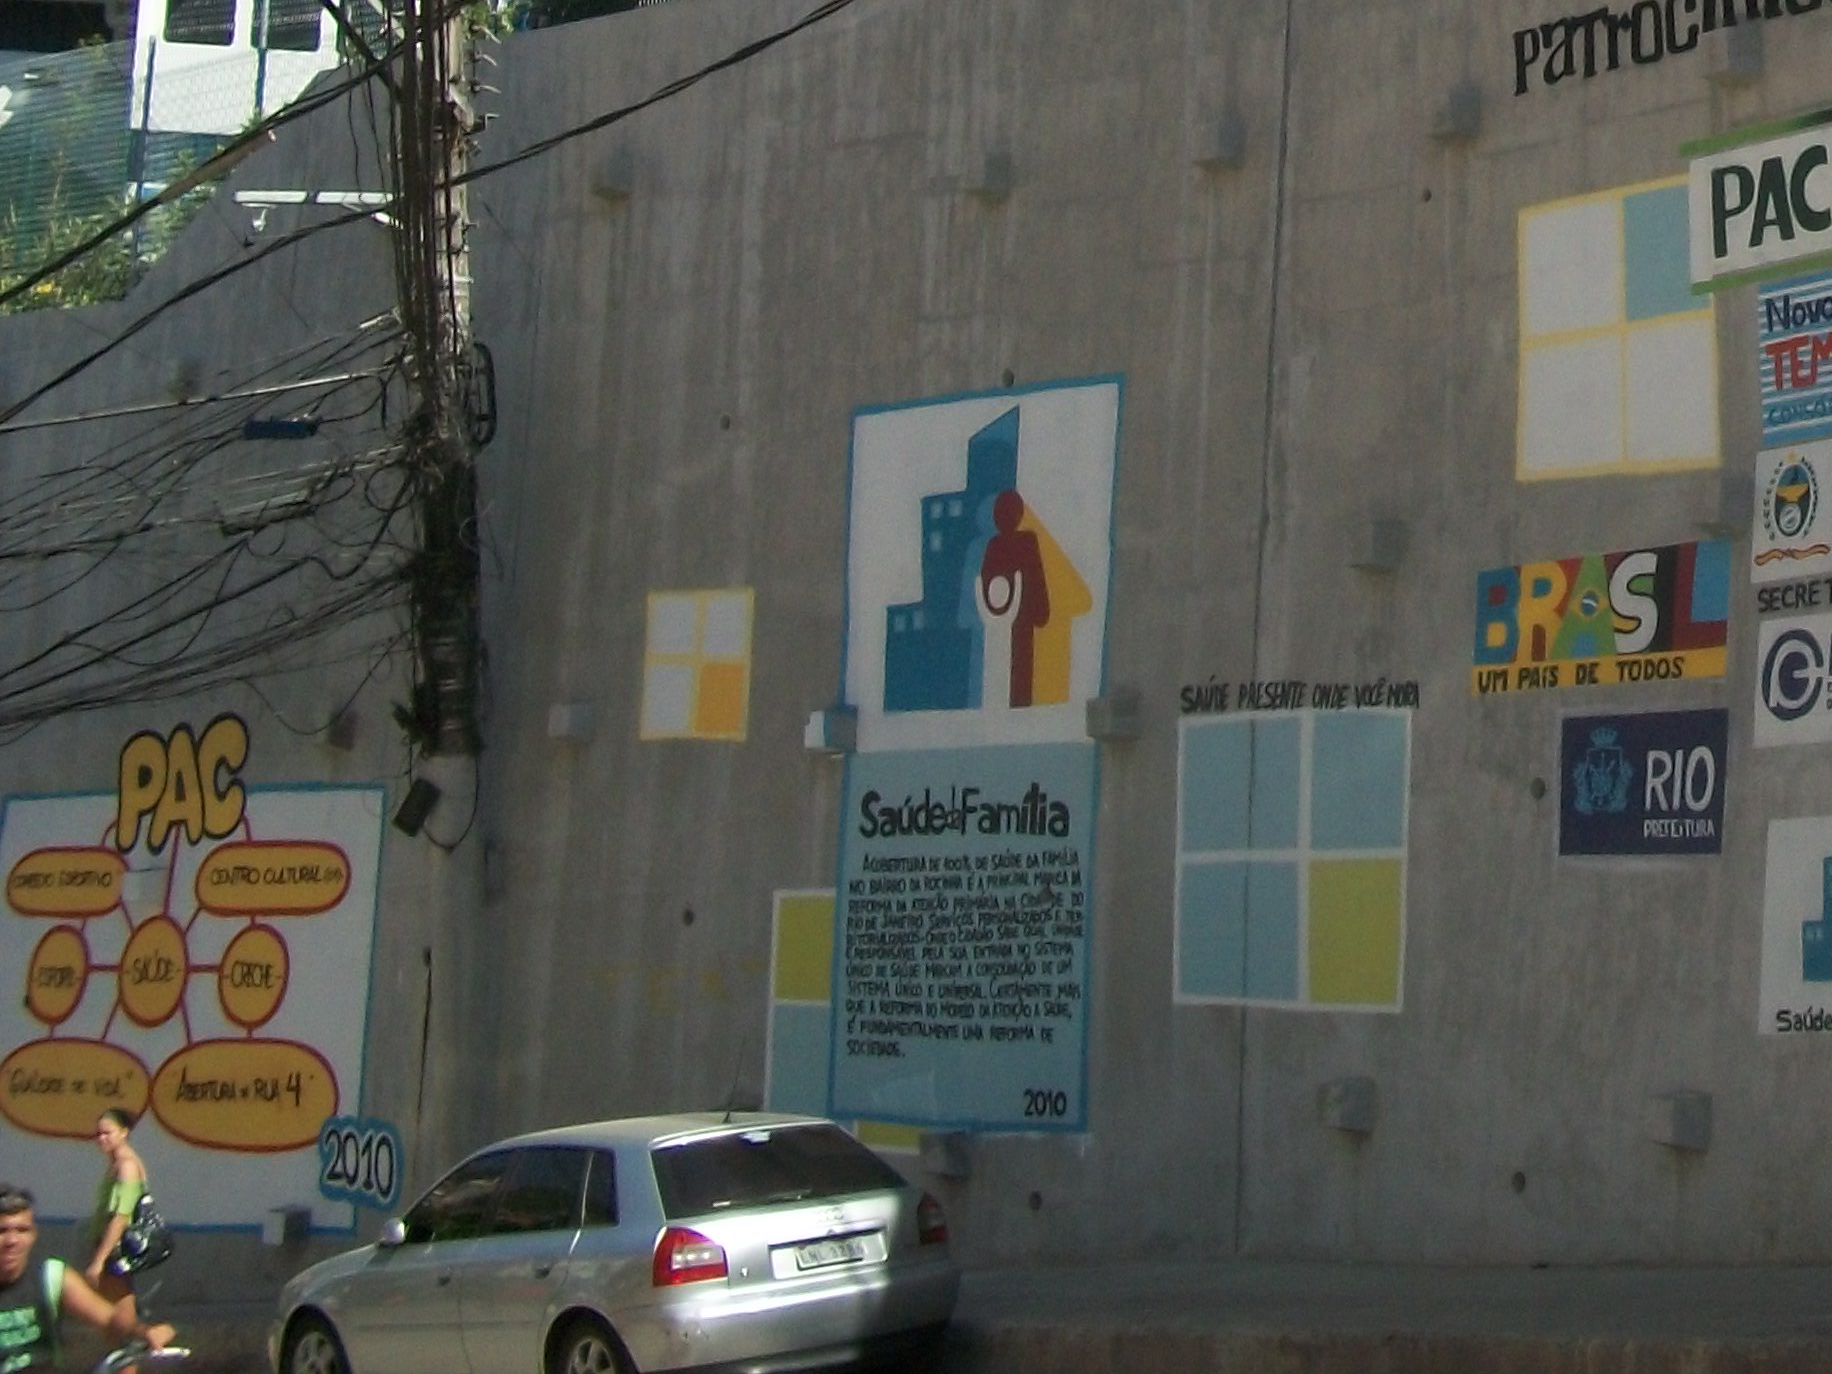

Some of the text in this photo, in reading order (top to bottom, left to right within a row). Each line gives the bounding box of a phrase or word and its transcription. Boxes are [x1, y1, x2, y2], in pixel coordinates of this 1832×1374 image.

[1710, 144, 1832, 259] PAC
[1478, 669, 1508, 693] UM
[1575, 662, 1600, 686] DE
[1615, 656, 1686, 682] TODOS
[117, 711, 249, 855] PAC
[1644, 744, 1716, 812] RIO
[858, 786, 946, 839] Saúde
[961, 782, 1071, 839] Família
[1643, 818, 1716, 839] PREFEITURA
[1023, 1088, 1067, 1117] 2010
[324, 1129, 393, 1197] 2010
